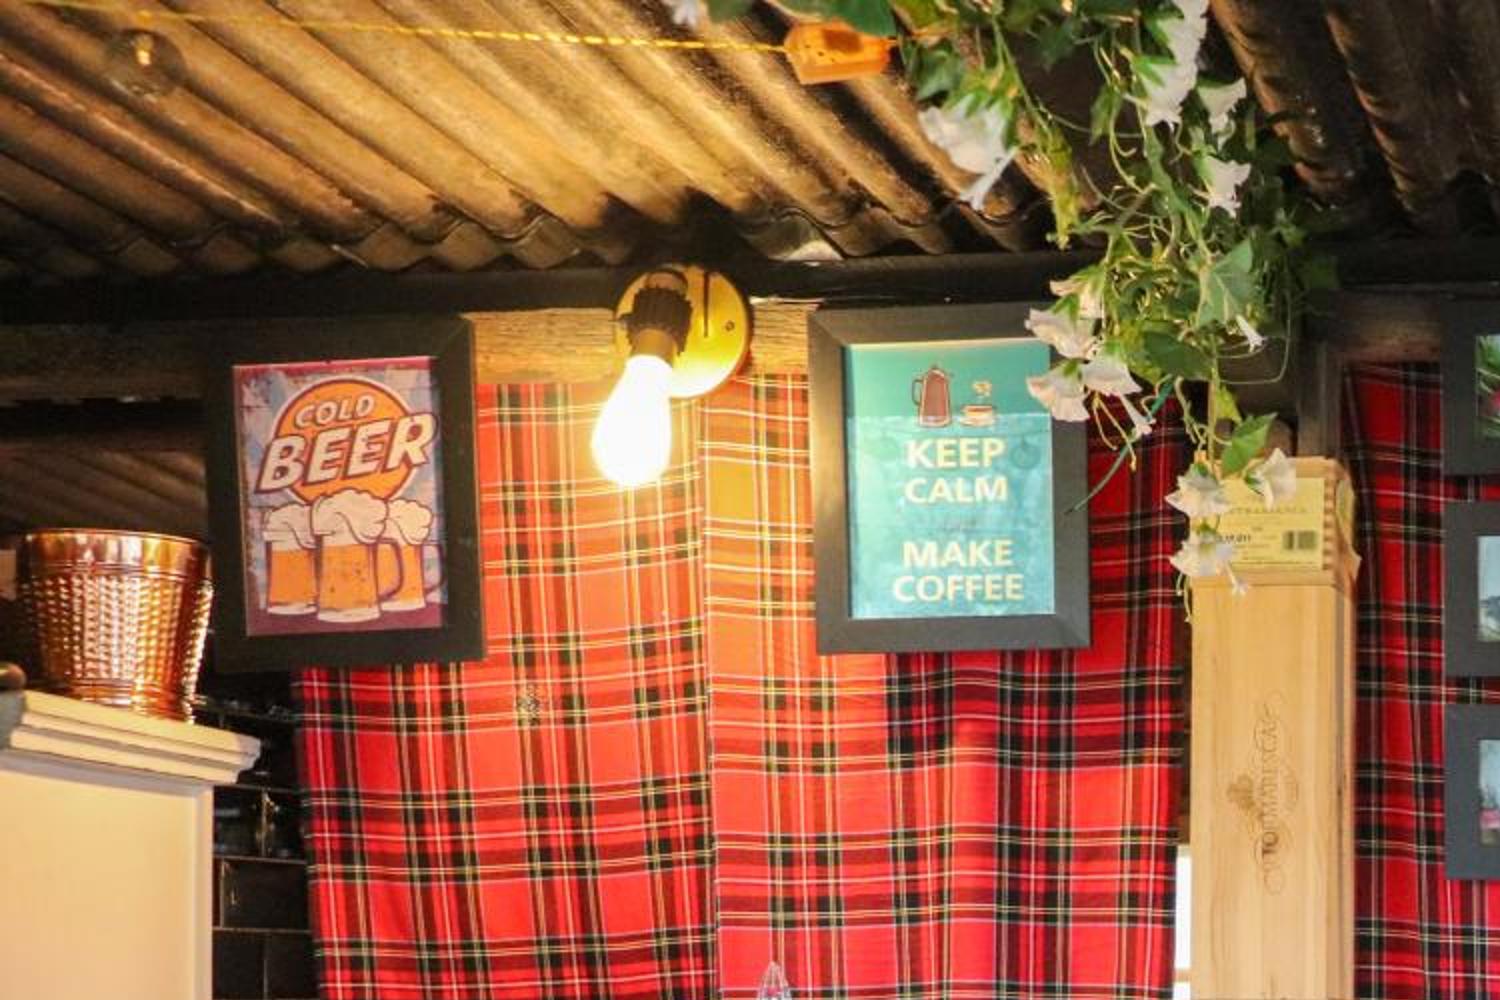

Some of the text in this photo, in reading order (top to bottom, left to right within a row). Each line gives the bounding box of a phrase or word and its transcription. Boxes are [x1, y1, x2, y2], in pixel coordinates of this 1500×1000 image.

[296, 394, 376, 429] COLD
[254, 412, 439, 494] BEER
[905, 437, 1006, 469] KEEP
[904, 475, 1009, 504] CALM
[902, 539, 1015, 569] MAKE
[892, 573, 1025, 603] COFFEE
